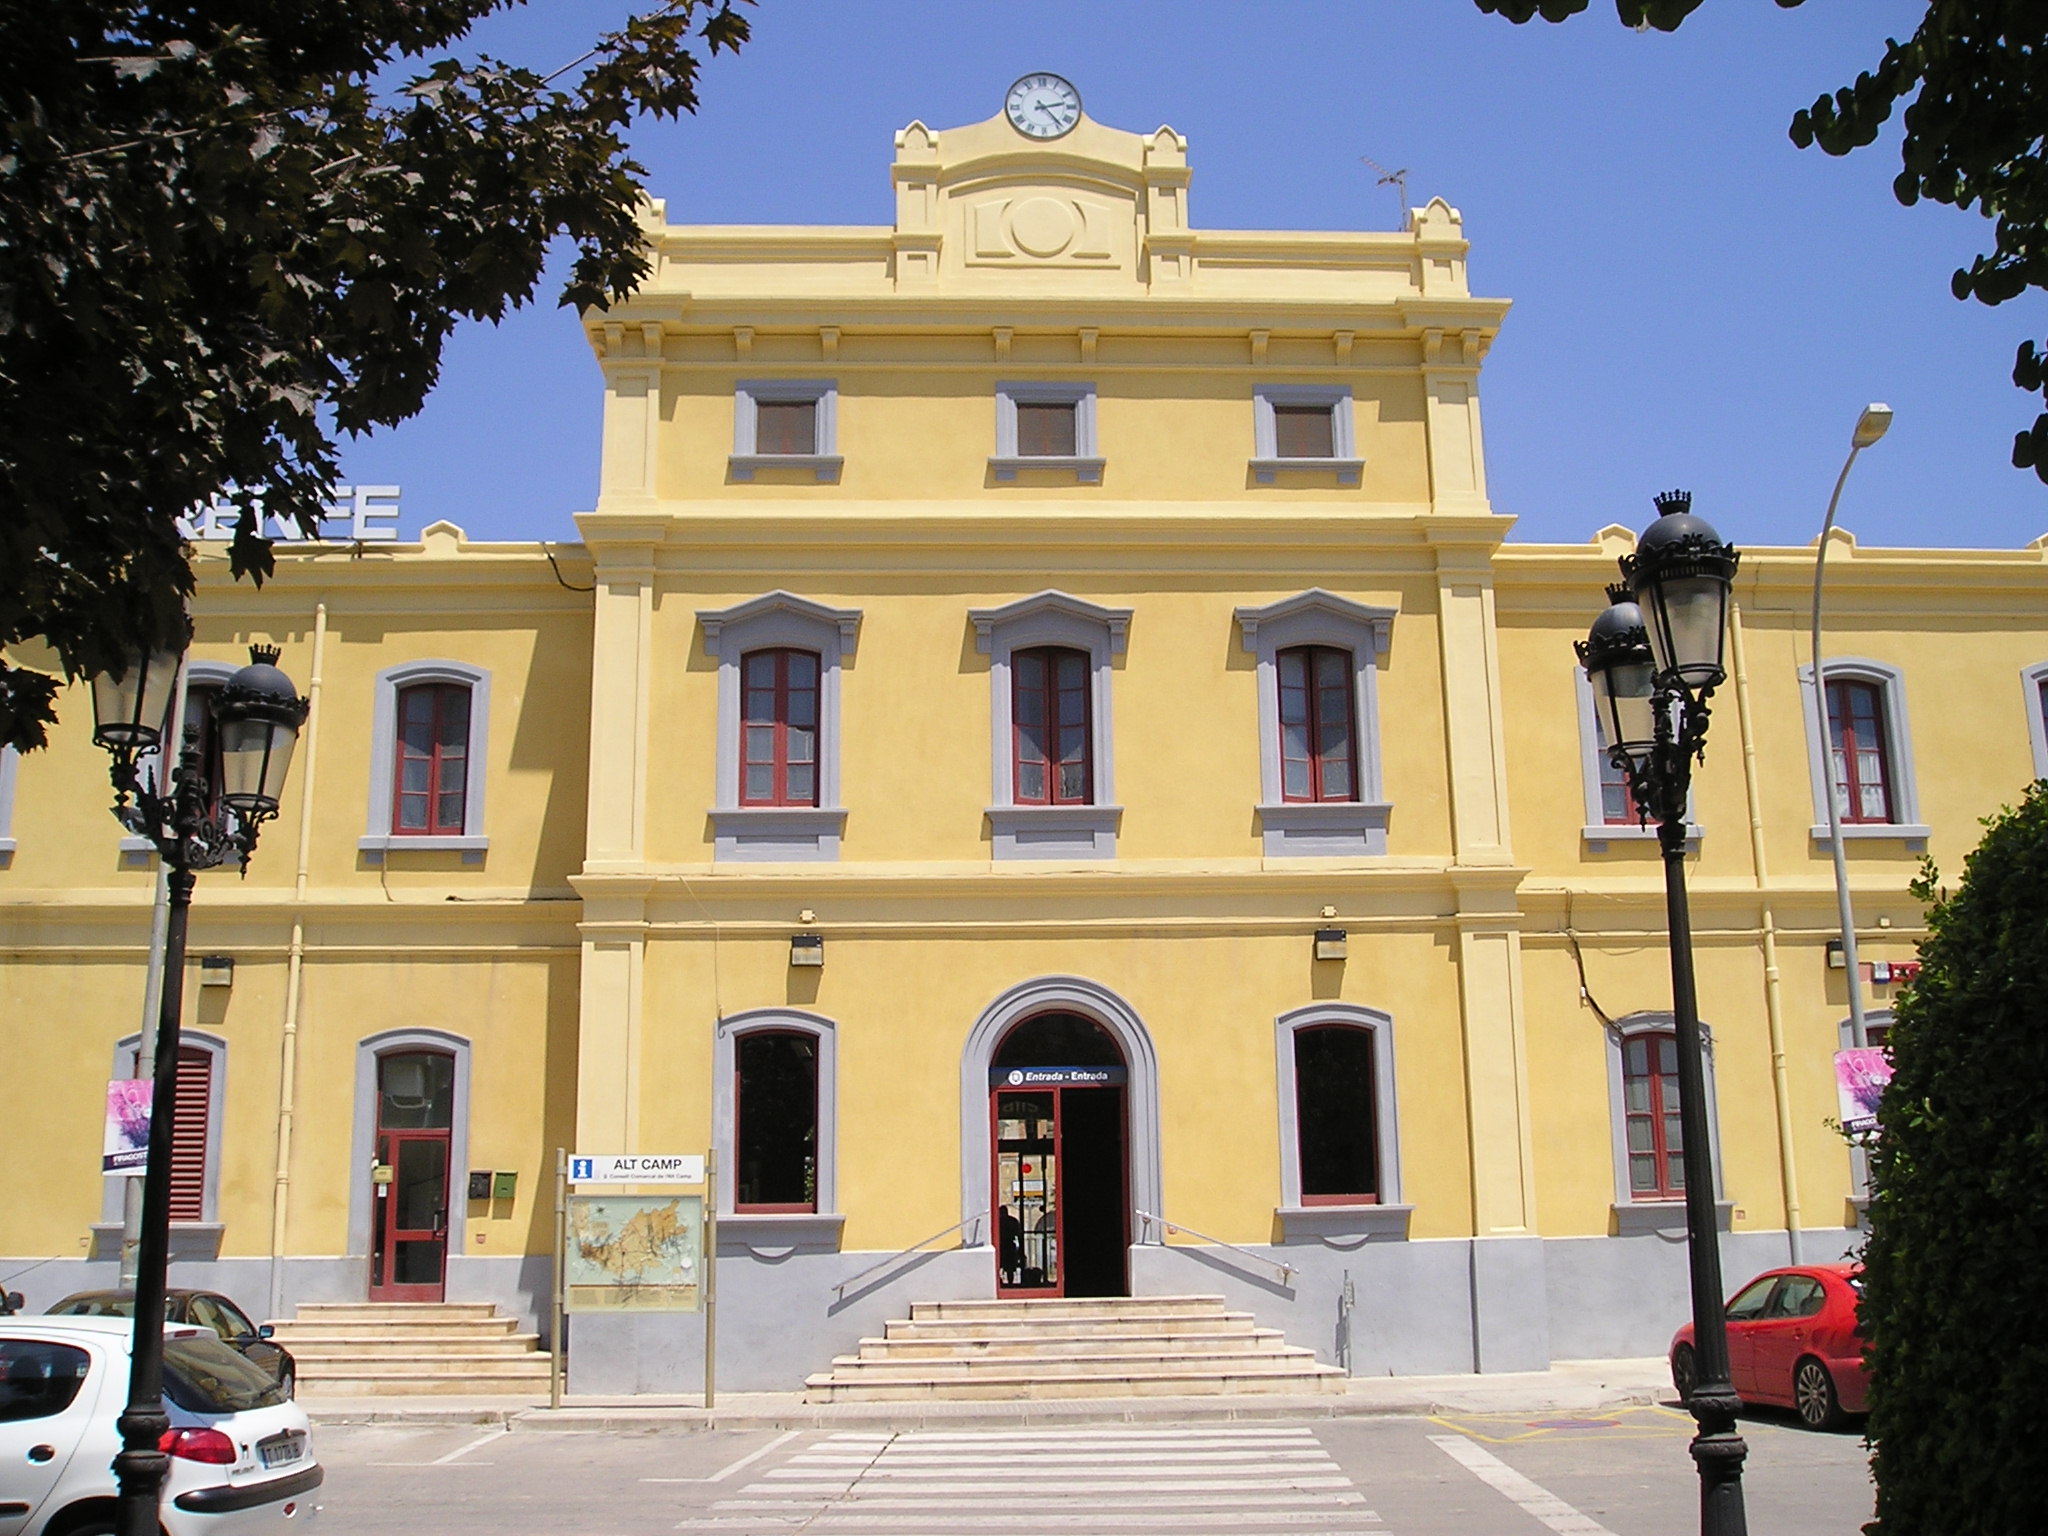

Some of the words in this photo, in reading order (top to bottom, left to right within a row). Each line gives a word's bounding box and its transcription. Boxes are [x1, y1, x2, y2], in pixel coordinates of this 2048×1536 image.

[1025, 1071, 1063, 1081] Entrada
[1071, 1071, 1108, 1081] Entrada
[614, 1159, 638, 1170] ALT
[641, 1158, 682, 1170] CAMP
